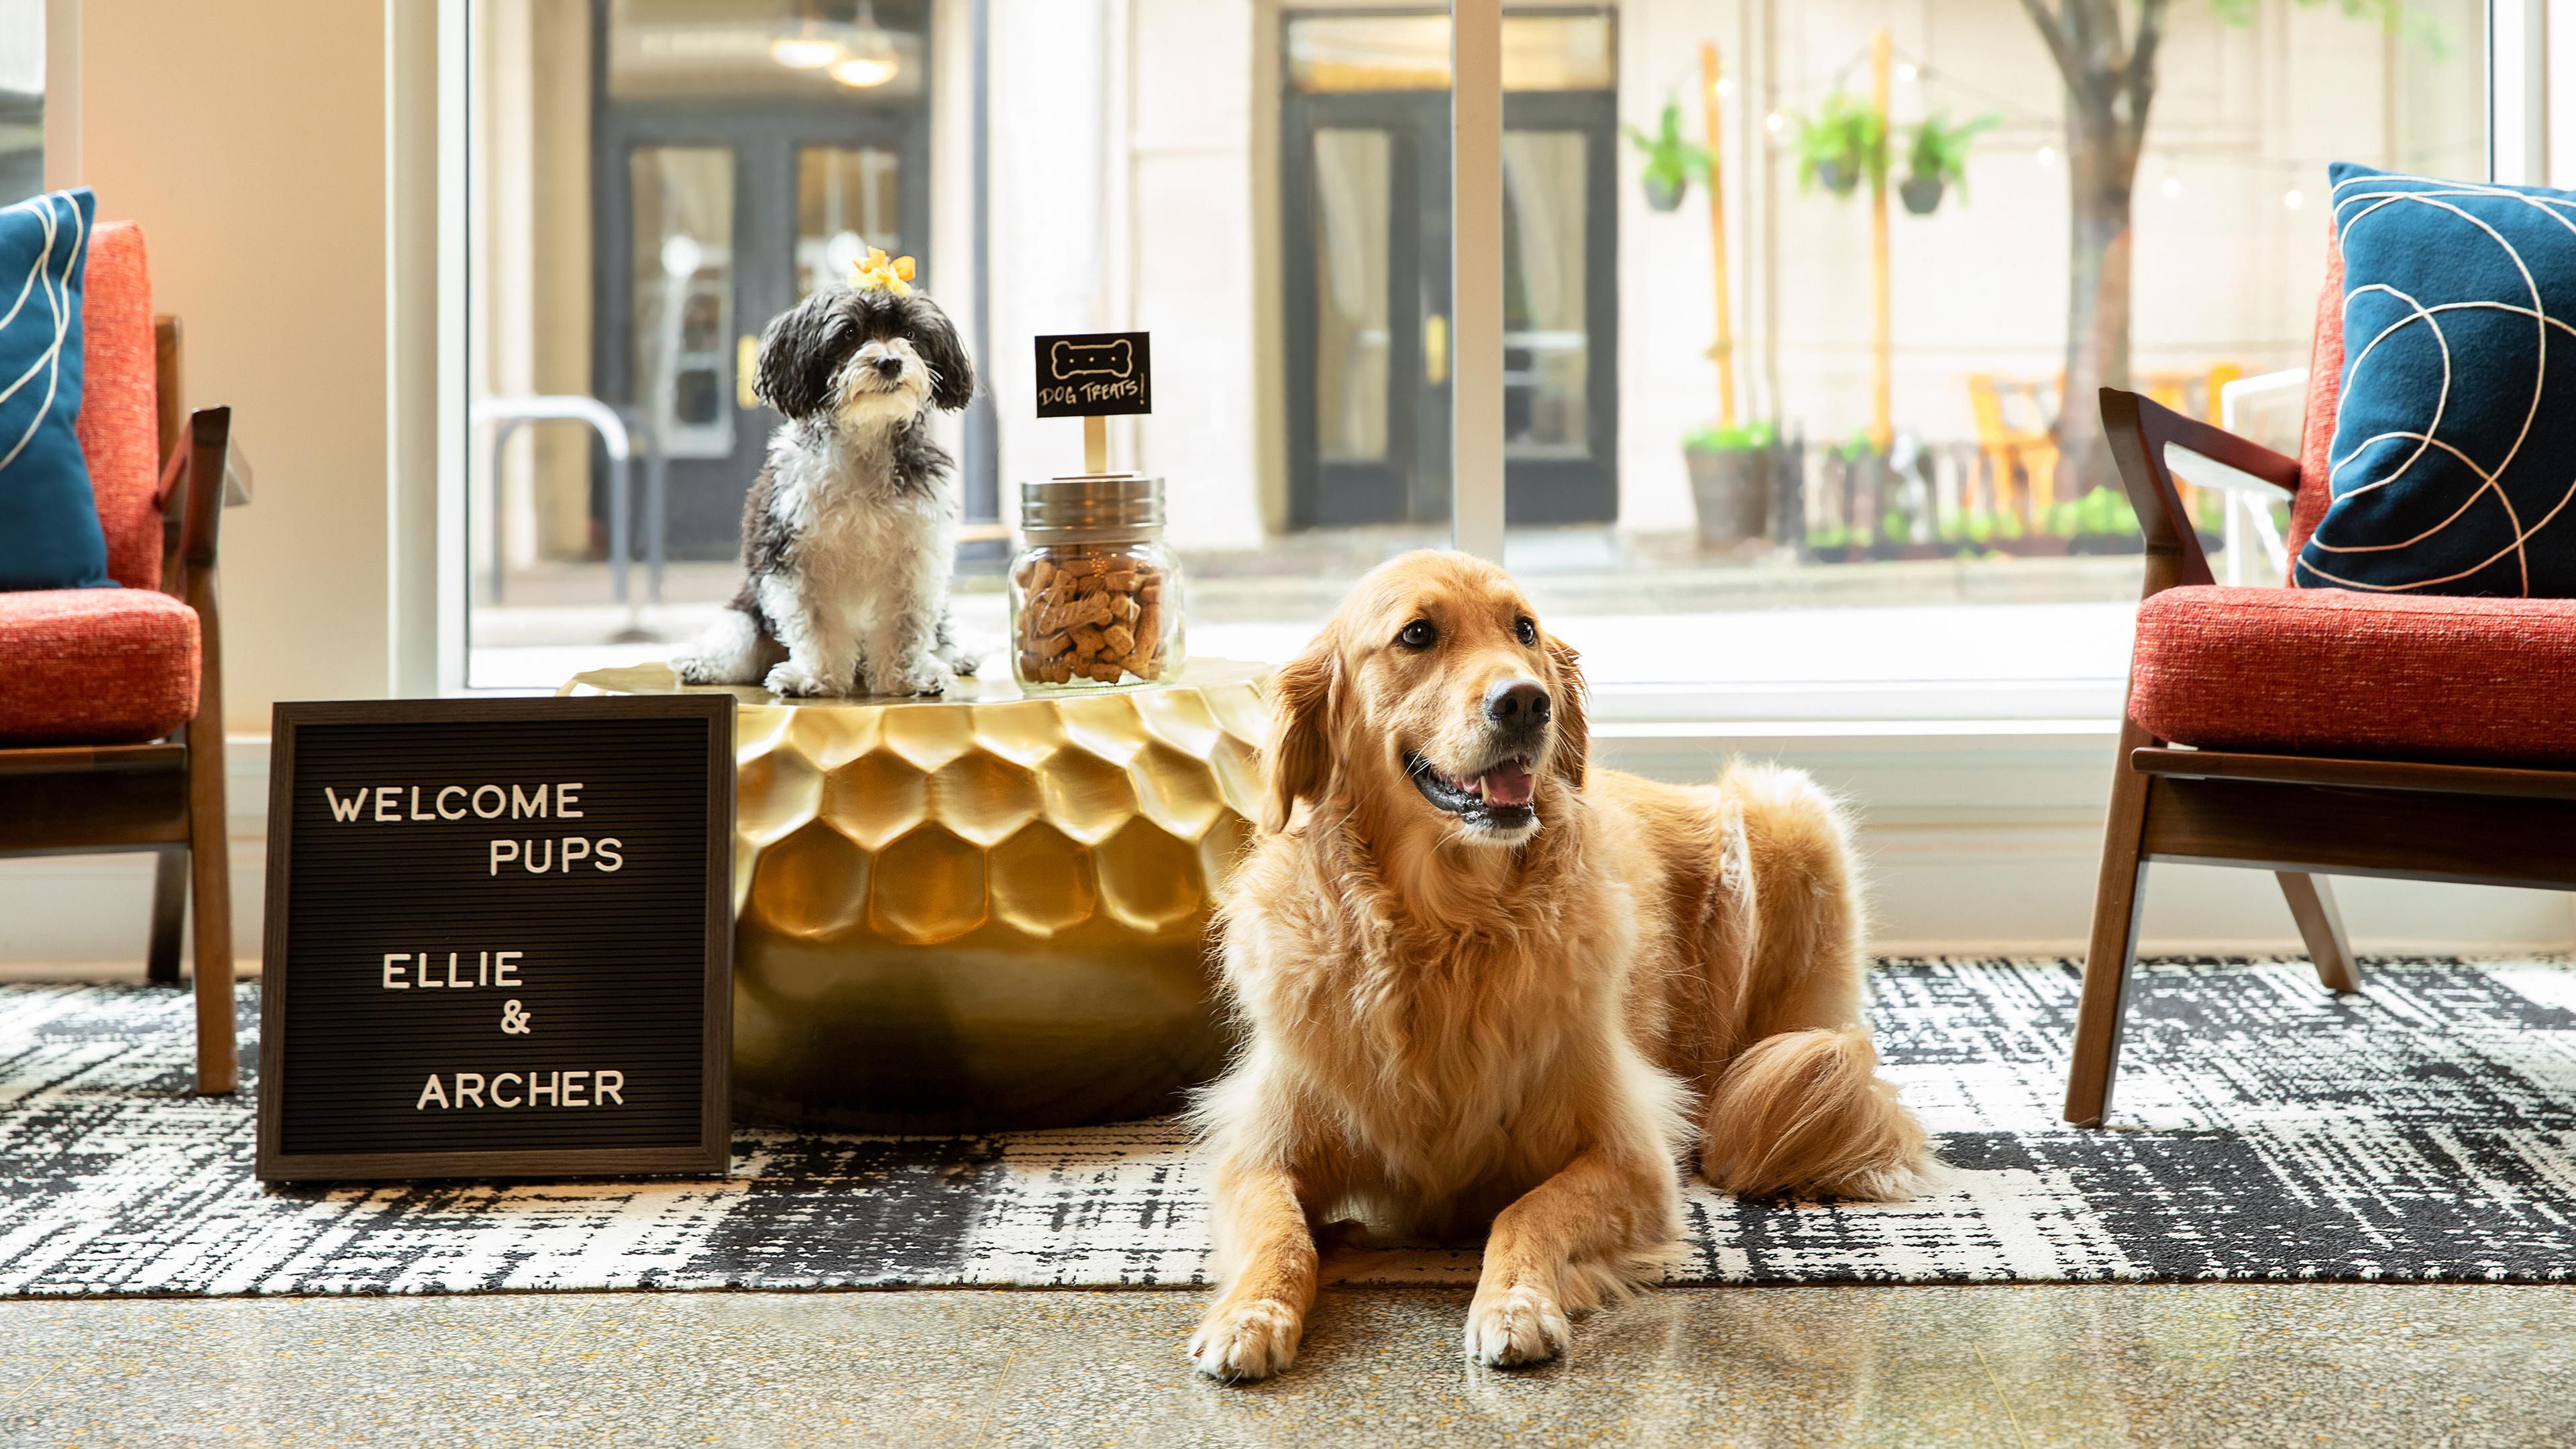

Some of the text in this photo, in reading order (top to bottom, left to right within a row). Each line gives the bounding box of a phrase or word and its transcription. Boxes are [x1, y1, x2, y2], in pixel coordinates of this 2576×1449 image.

[1039, 372, 1144, 406] DOG TREATS!
[325, 783, 584, 822] WELCOME
[490, 837, 623, 876] PUPS
[383, 951, 523, 989] ELLIE
[500, 999, 531, 1034] &
[417, 1070, 624, 1110] ARCHER
